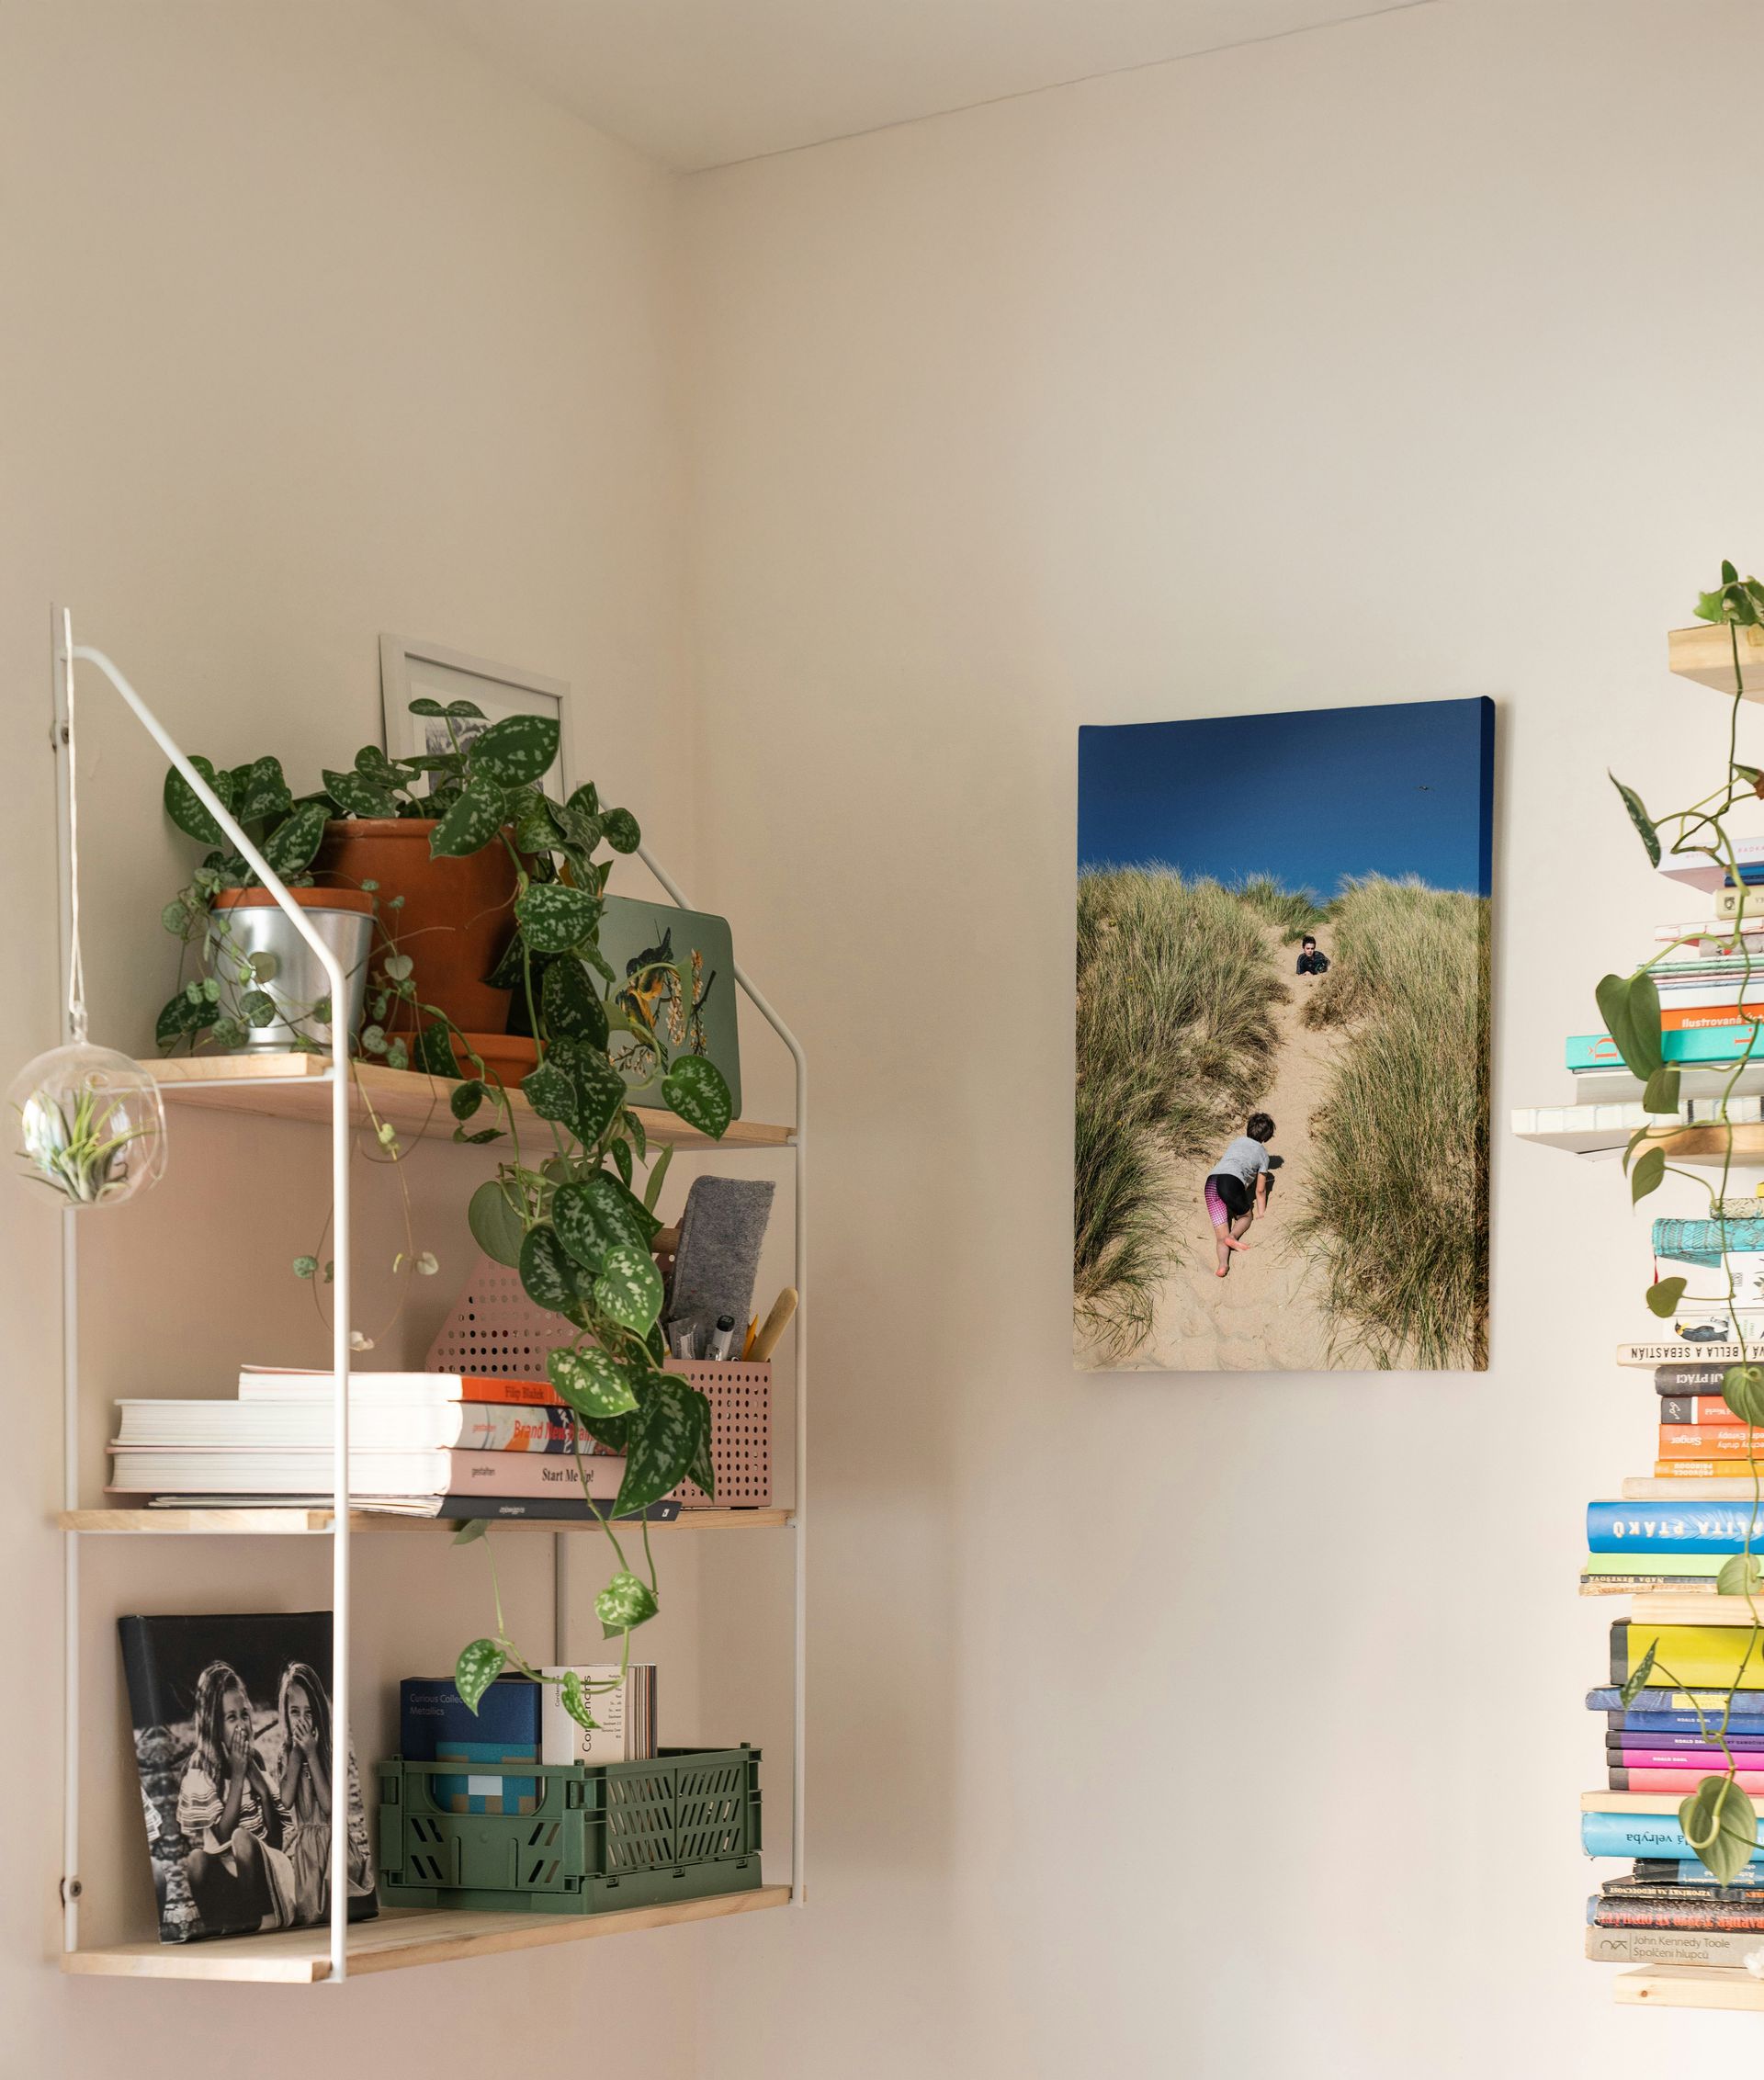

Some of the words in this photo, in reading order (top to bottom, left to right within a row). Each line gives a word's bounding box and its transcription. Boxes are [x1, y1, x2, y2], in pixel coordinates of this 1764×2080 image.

[1681, 1014, 1742, 1028] Ilustrovaná
[1631, 1346, 1691, 1361] SEBASTIÁN
[1695, 1346, 1702, 1358] A
[1706, 1346, 1739, 1358] BELLA
[1676, 1373, 1709, 1385] PTÁCI
[514, 1419, 542, 1440] Brand
[1670, 1435, 1702, 1447] Singer
[541, 1468, 563, 1482] Start
[565, 1468, 579, 1483] Me
[580, 1469, 594, 1483] p!
[1612, 1520, 1685, 1539] PTÁKŮ
[410, 1693, 439, 1703] Curious
[410, 1707, 445, 1716] Metallics
[1626, 1831, 1672, 1843] velryba
[1609, 1887, 1657, 1895] BUDOUCNOST
[1633, 1936, 1657, 1946] John
[1658, 1936, 1702, 1948] Kennedy
[1702, 1938, 1731, 1949] Toole
[1675, 1948, 1710, 1960] hlupců
